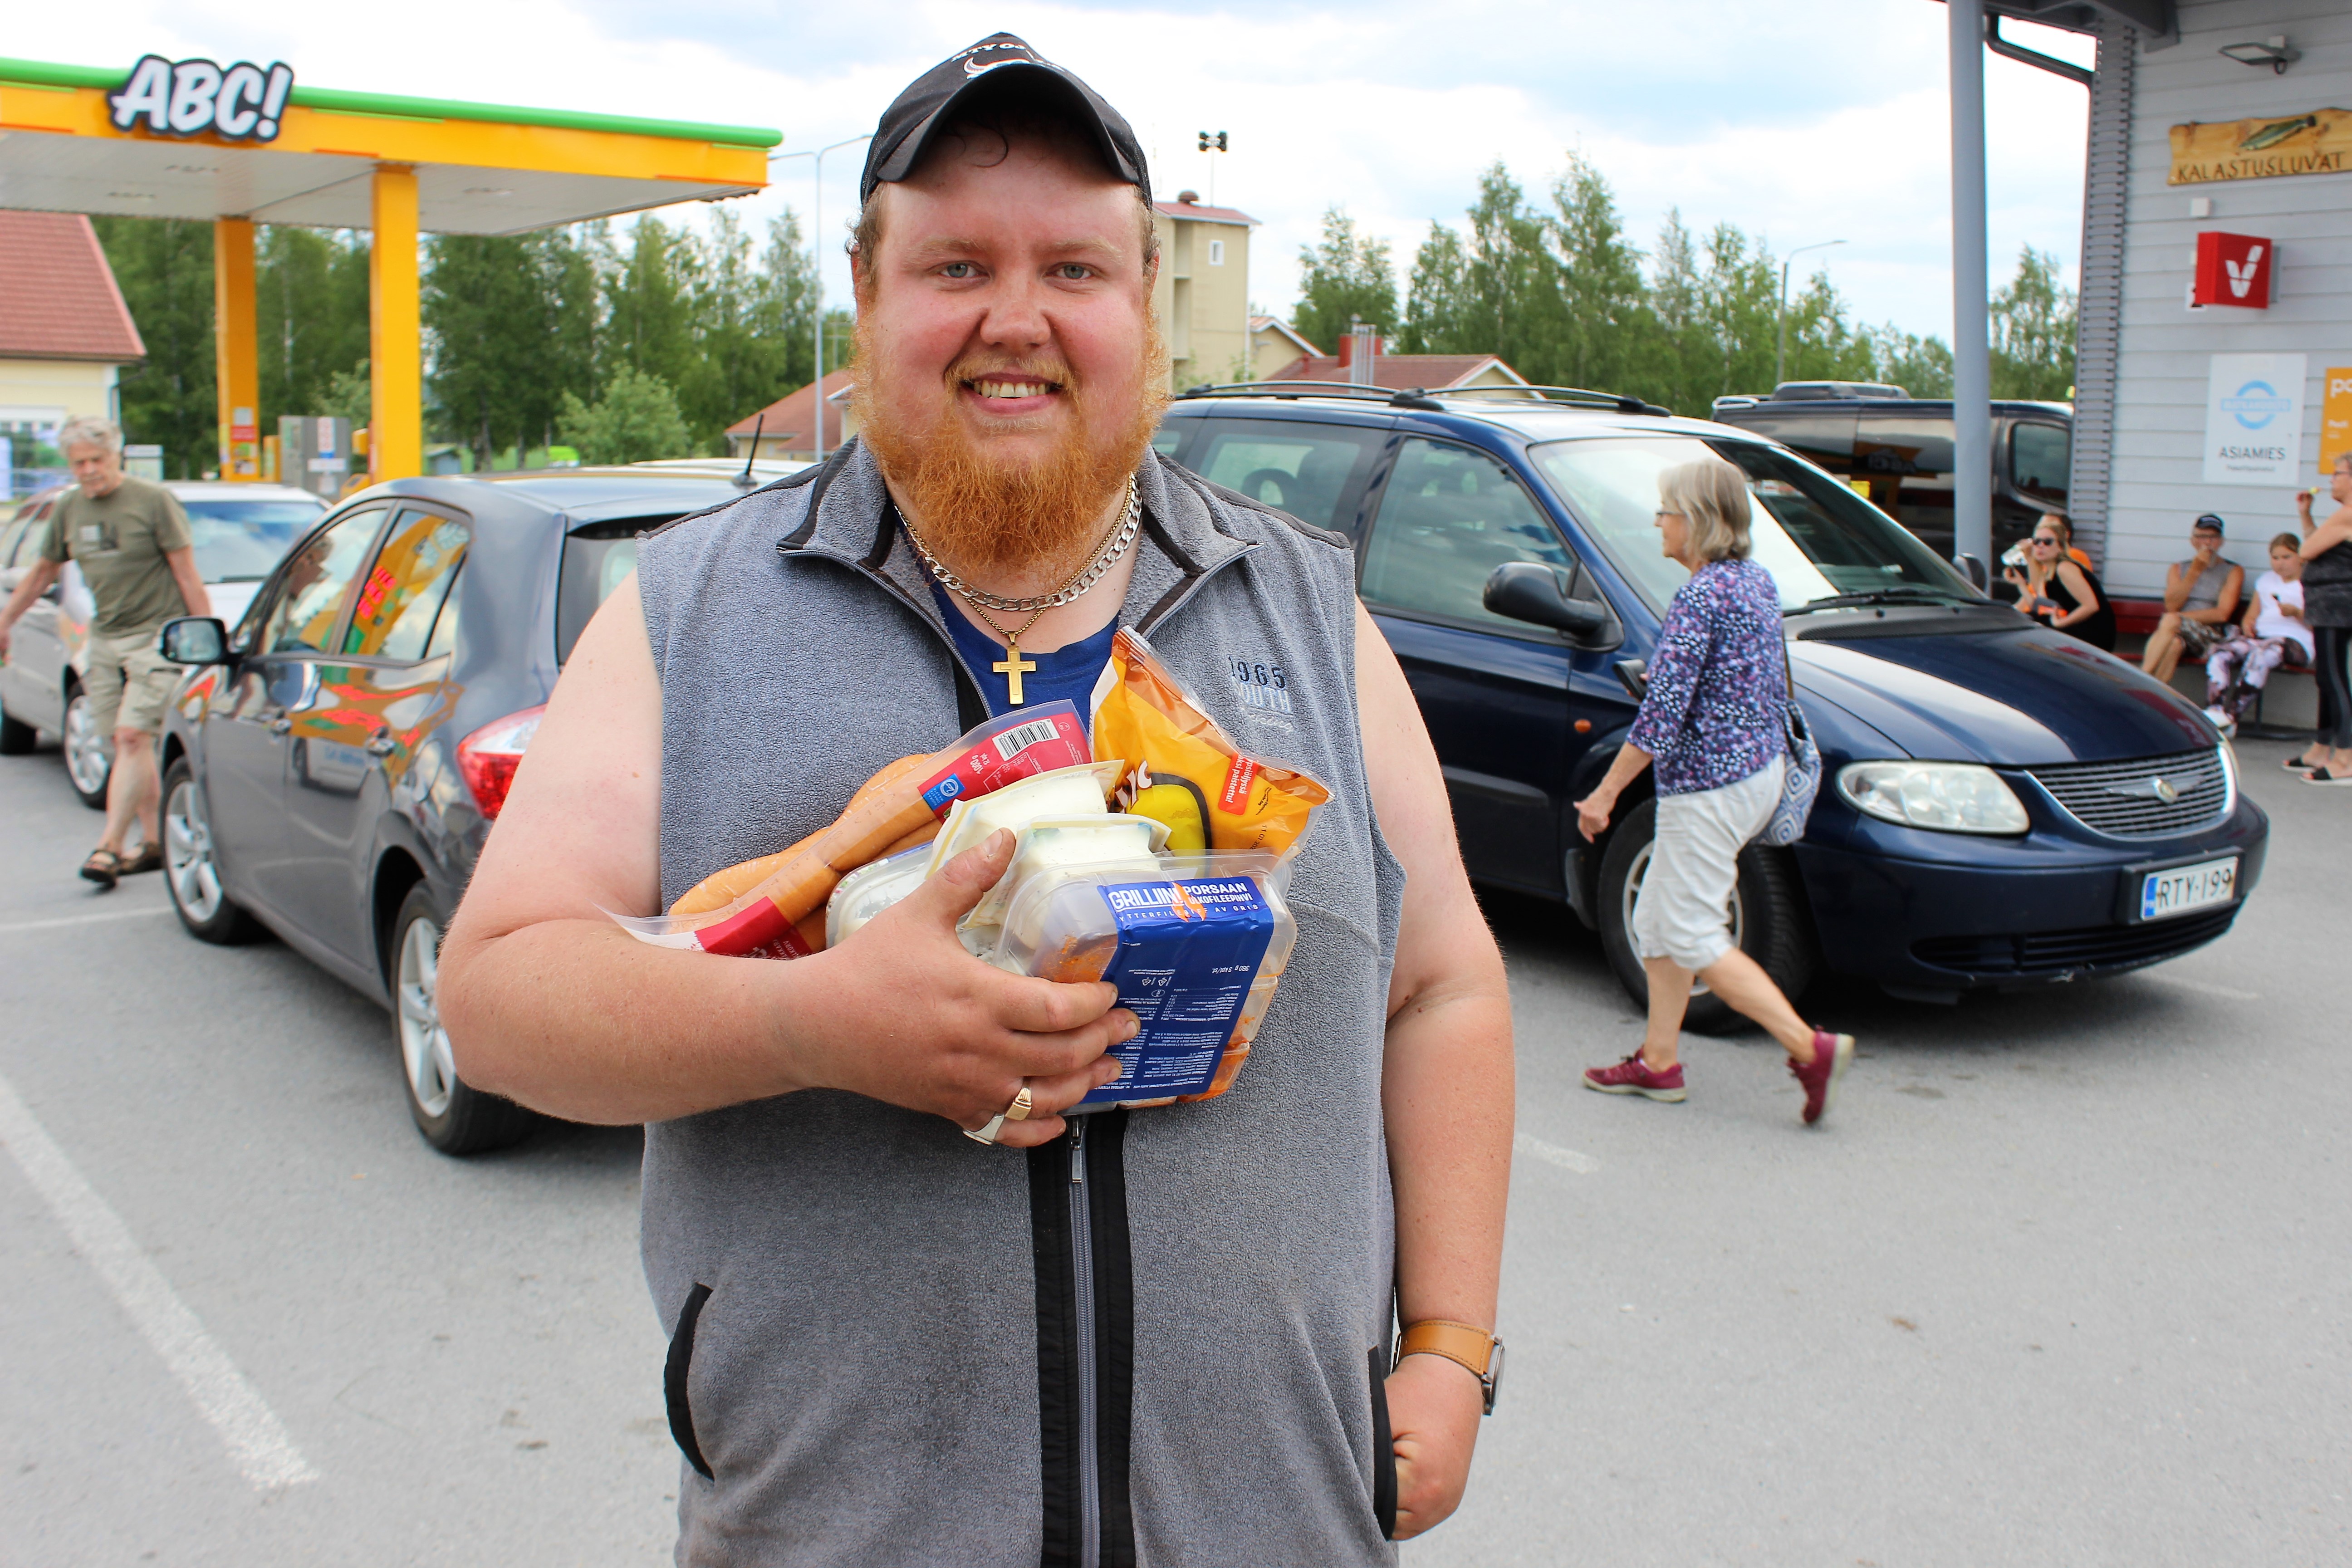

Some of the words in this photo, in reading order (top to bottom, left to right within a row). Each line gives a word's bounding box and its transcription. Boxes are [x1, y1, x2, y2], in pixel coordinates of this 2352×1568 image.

[111, 57, 293, 138] ABC!
[2178, 151, 2347, 182] KALASTUSLUVAT
[2219, 446, 2286, 461] ASIAMIES
[1229, 656, 1286, 689] 1965
[970, 759, 984, 774] 1000
[1225, 769, 1240, 804] paistettu!
[1108, 887, 1183, 909] GRILLIIN!
[1185, 882, 1248, 896] PORSAAN
[1189, 892, 1253, 905] ULKOFILEEPIHVI
[2159, 867, 2232, 908] RTY-199
